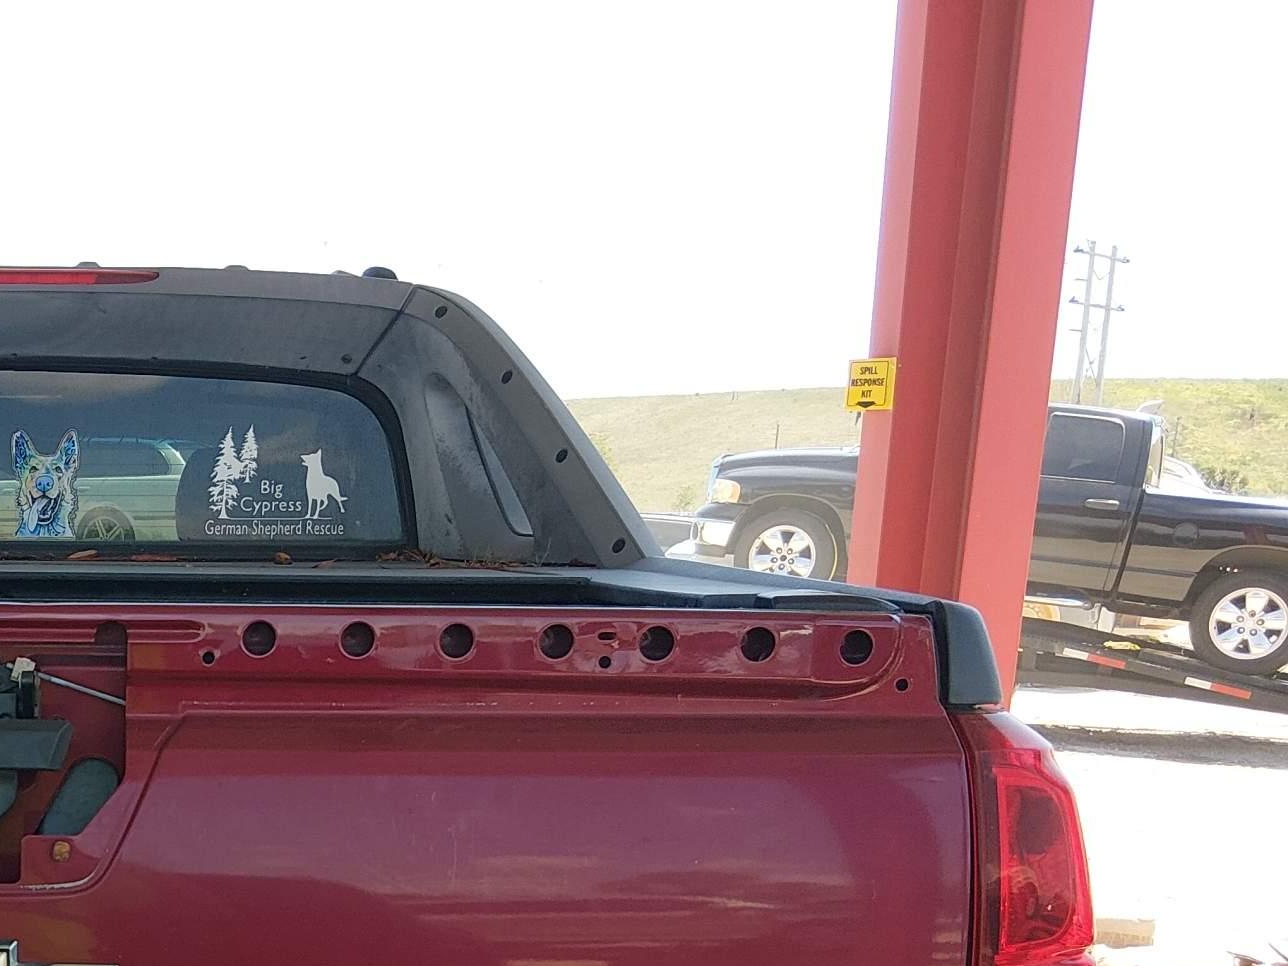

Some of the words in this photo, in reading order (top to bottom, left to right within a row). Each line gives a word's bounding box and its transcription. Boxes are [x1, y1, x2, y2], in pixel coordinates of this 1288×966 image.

[859, 366, 878, 375] SPILL
[851, 378, 885, 387] RESPONSE
[861, 390, 872, 398] KIT
[260, 480, 284, 498] Big
[240, 497, 302, 516] Cypress
[204, 520, 248, 535] German
[252, 520, 302, 540] Shepherd
[306, 520, 345, 535] Rescue
